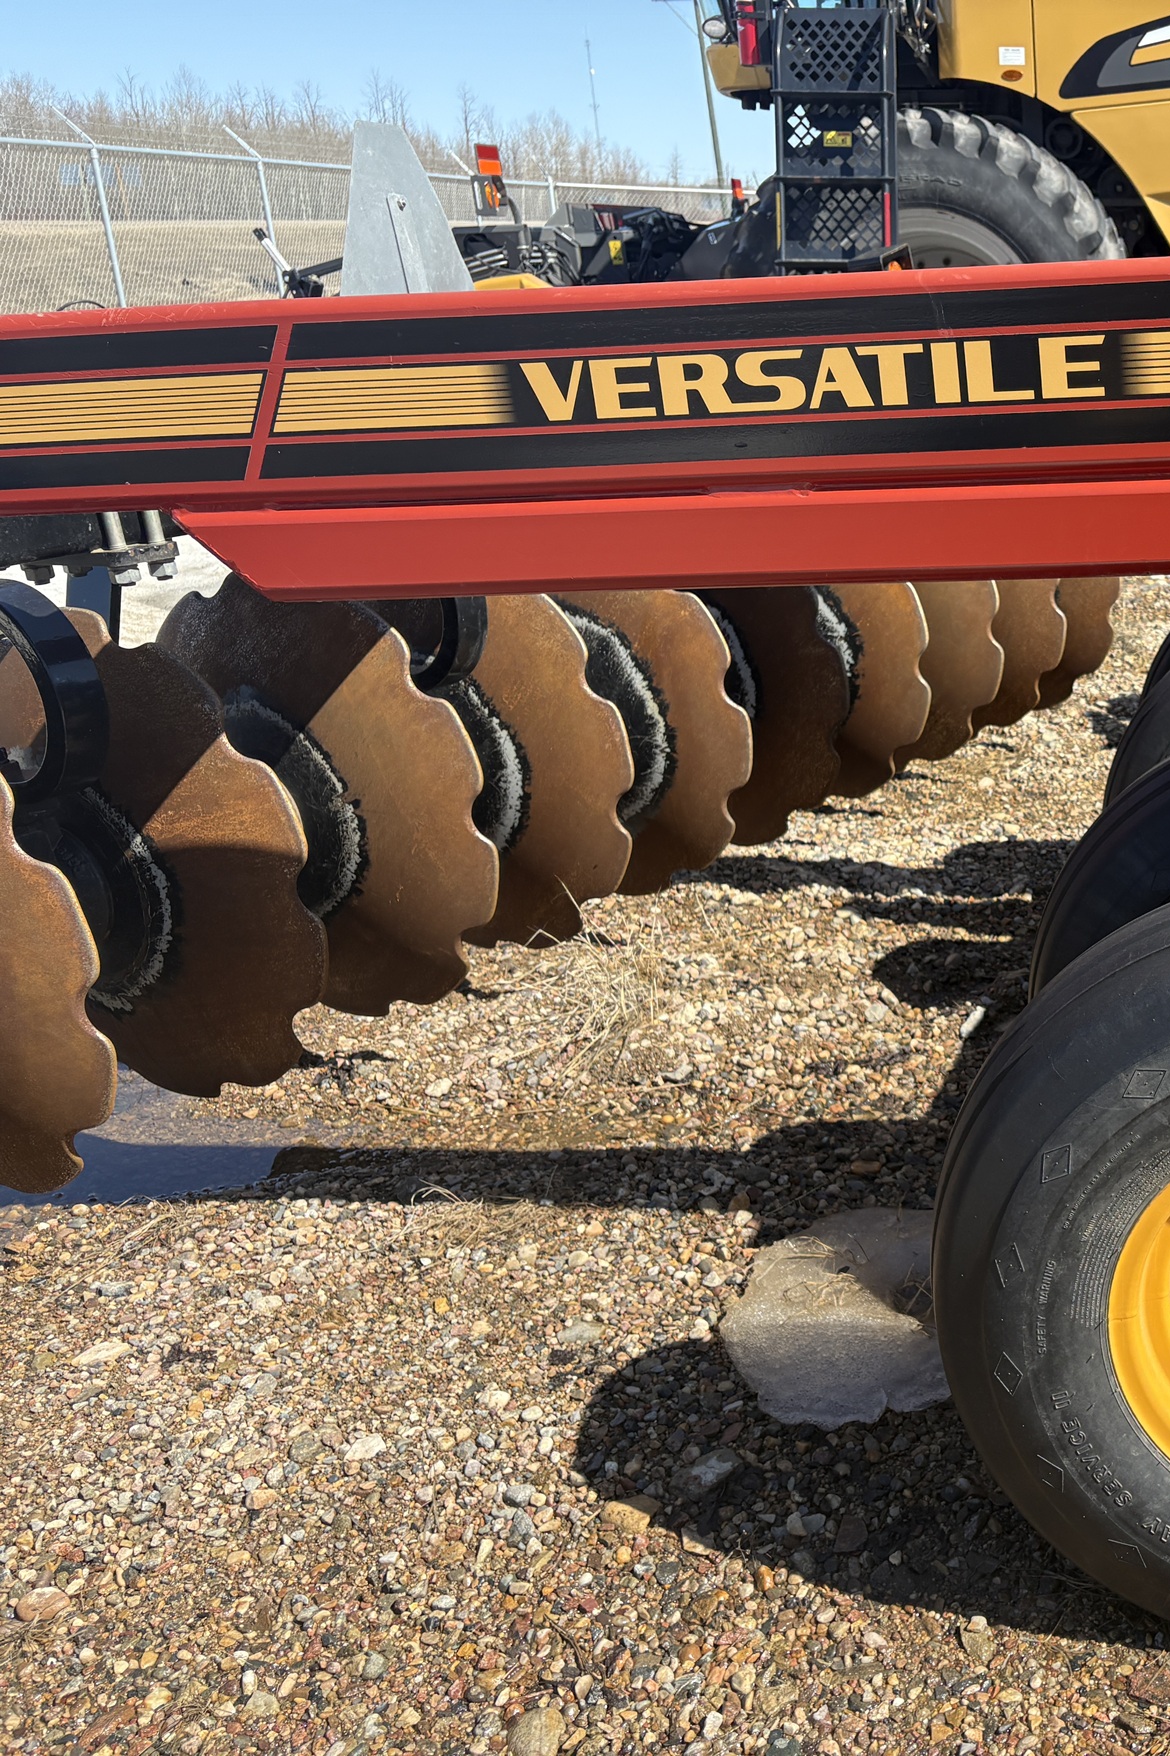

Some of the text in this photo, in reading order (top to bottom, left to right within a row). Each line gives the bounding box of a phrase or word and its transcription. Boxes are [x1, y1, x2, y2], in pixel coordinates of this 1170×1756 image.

[519, 335, 1106, 422] VERSATILE
[1035, 1259, 1057, 1358] SAFETY WARNING
[1060, 1416, 1134, 1507] SERVICE
